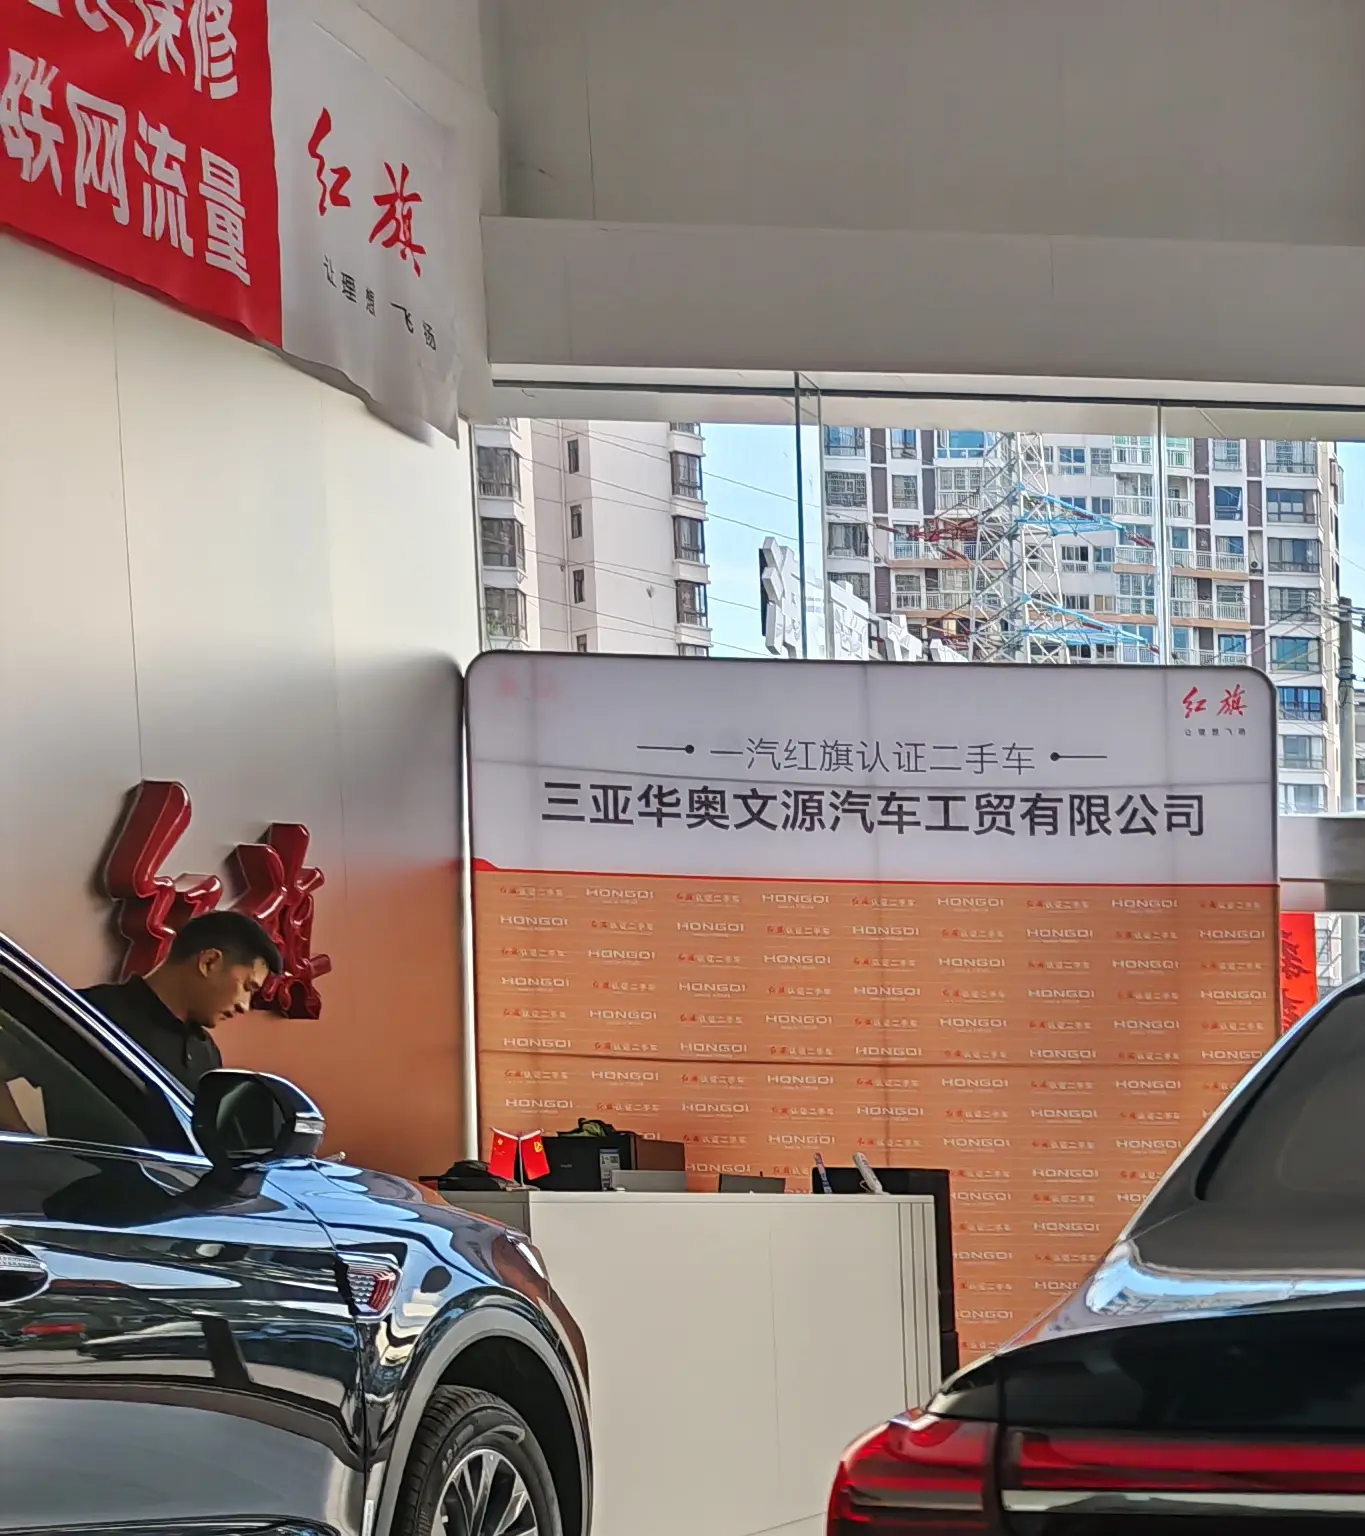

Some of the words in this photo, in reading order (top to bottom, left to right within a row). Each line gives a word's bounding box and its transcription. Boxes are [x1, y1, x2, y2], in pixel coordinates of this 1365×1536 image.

[28, 0, 240, 99] 保修
[0, 48, 251, 286] 联网流量
[308, 107, 427, 278] 红旗
[1182, 683, 1248, 719] 红旗
[710, 738, 1035, 774] 一汽红旗认证二手车
[541, 780, 1205, 837] 三亚华奥文源汽车工贸有限公司
[1202, 1049, 1262, 1059] HONGQ
[1117, 1193, 1150, 1202] HON
[1035, 1280, 1079, 1290] HON
[957, 1310, 1013, 1320] ONGQI
